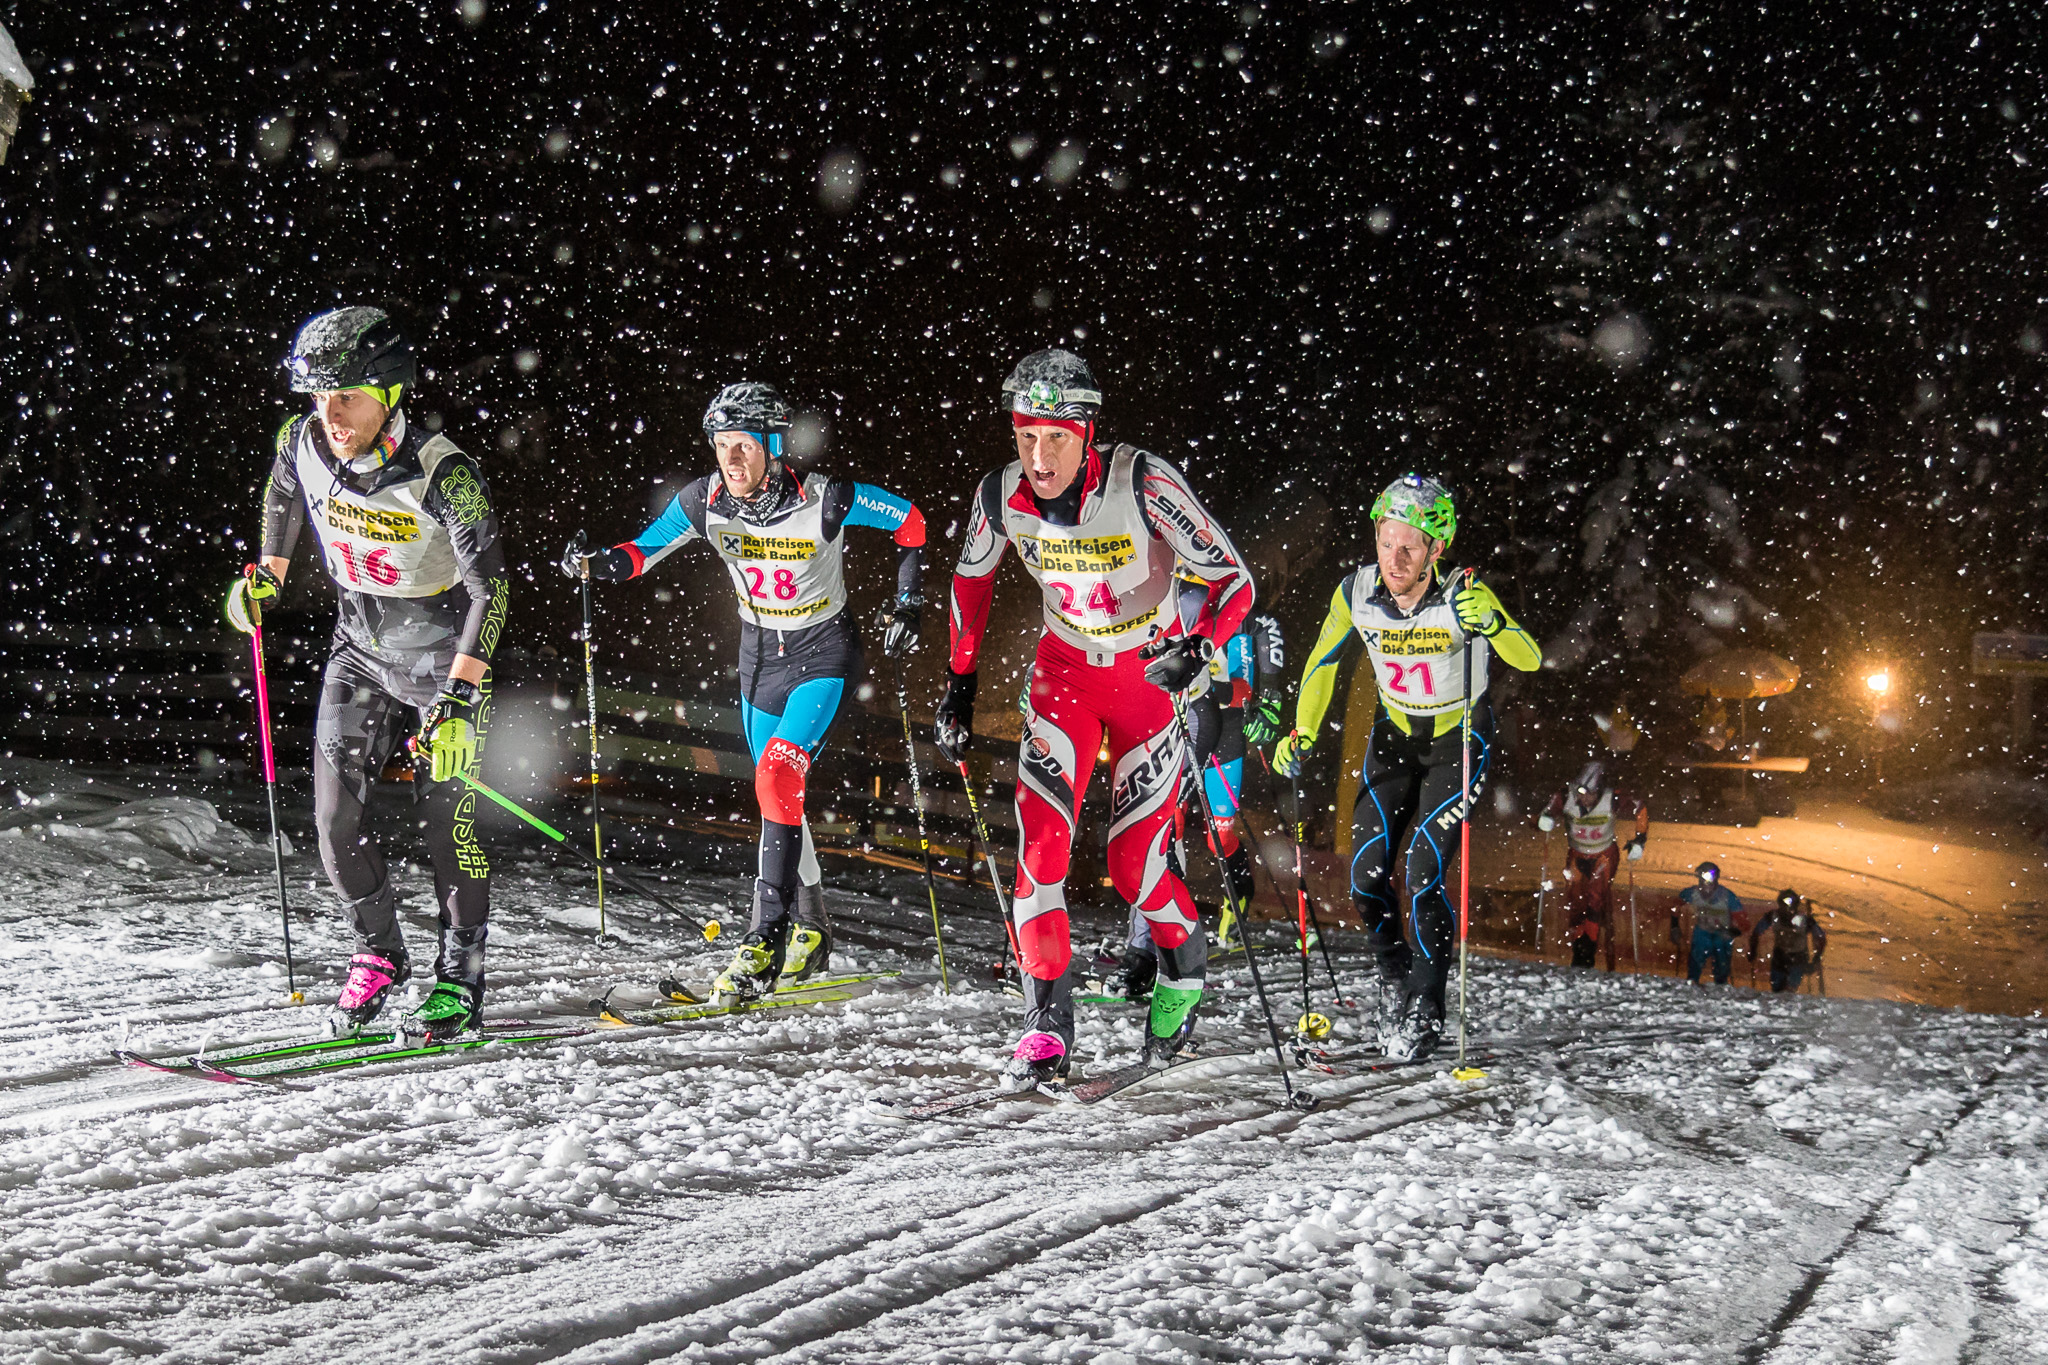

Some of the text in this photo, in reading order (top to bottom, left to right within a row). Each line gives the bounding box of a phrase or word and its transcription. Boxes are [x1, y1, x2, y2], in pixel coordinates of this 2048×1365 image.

[328, 497, 415, 526] Raiffeisen
[857, 494, 908, 523] MARTINI
[328, 515, 408, 541] Die Bank
[743, 536, 813, 548] Raiffeisen
[743, 548, 807, 560] Die Bank
[1041, 538, 1132, 554] Raiffeisen
[330, 540, 402, 587] 16
[1044, 555, 1125, 573] Die Bank
[744, 566, 800, 601] 28
[1046, 579, 1122, 618] 24
[1382, 628, 1450, 641] Raiffeisen
[1382, 643, 1443, 655] Die Bank
[1382, 661, 1436, 697] 21
[1437, 773, 1486, 830] MILET
